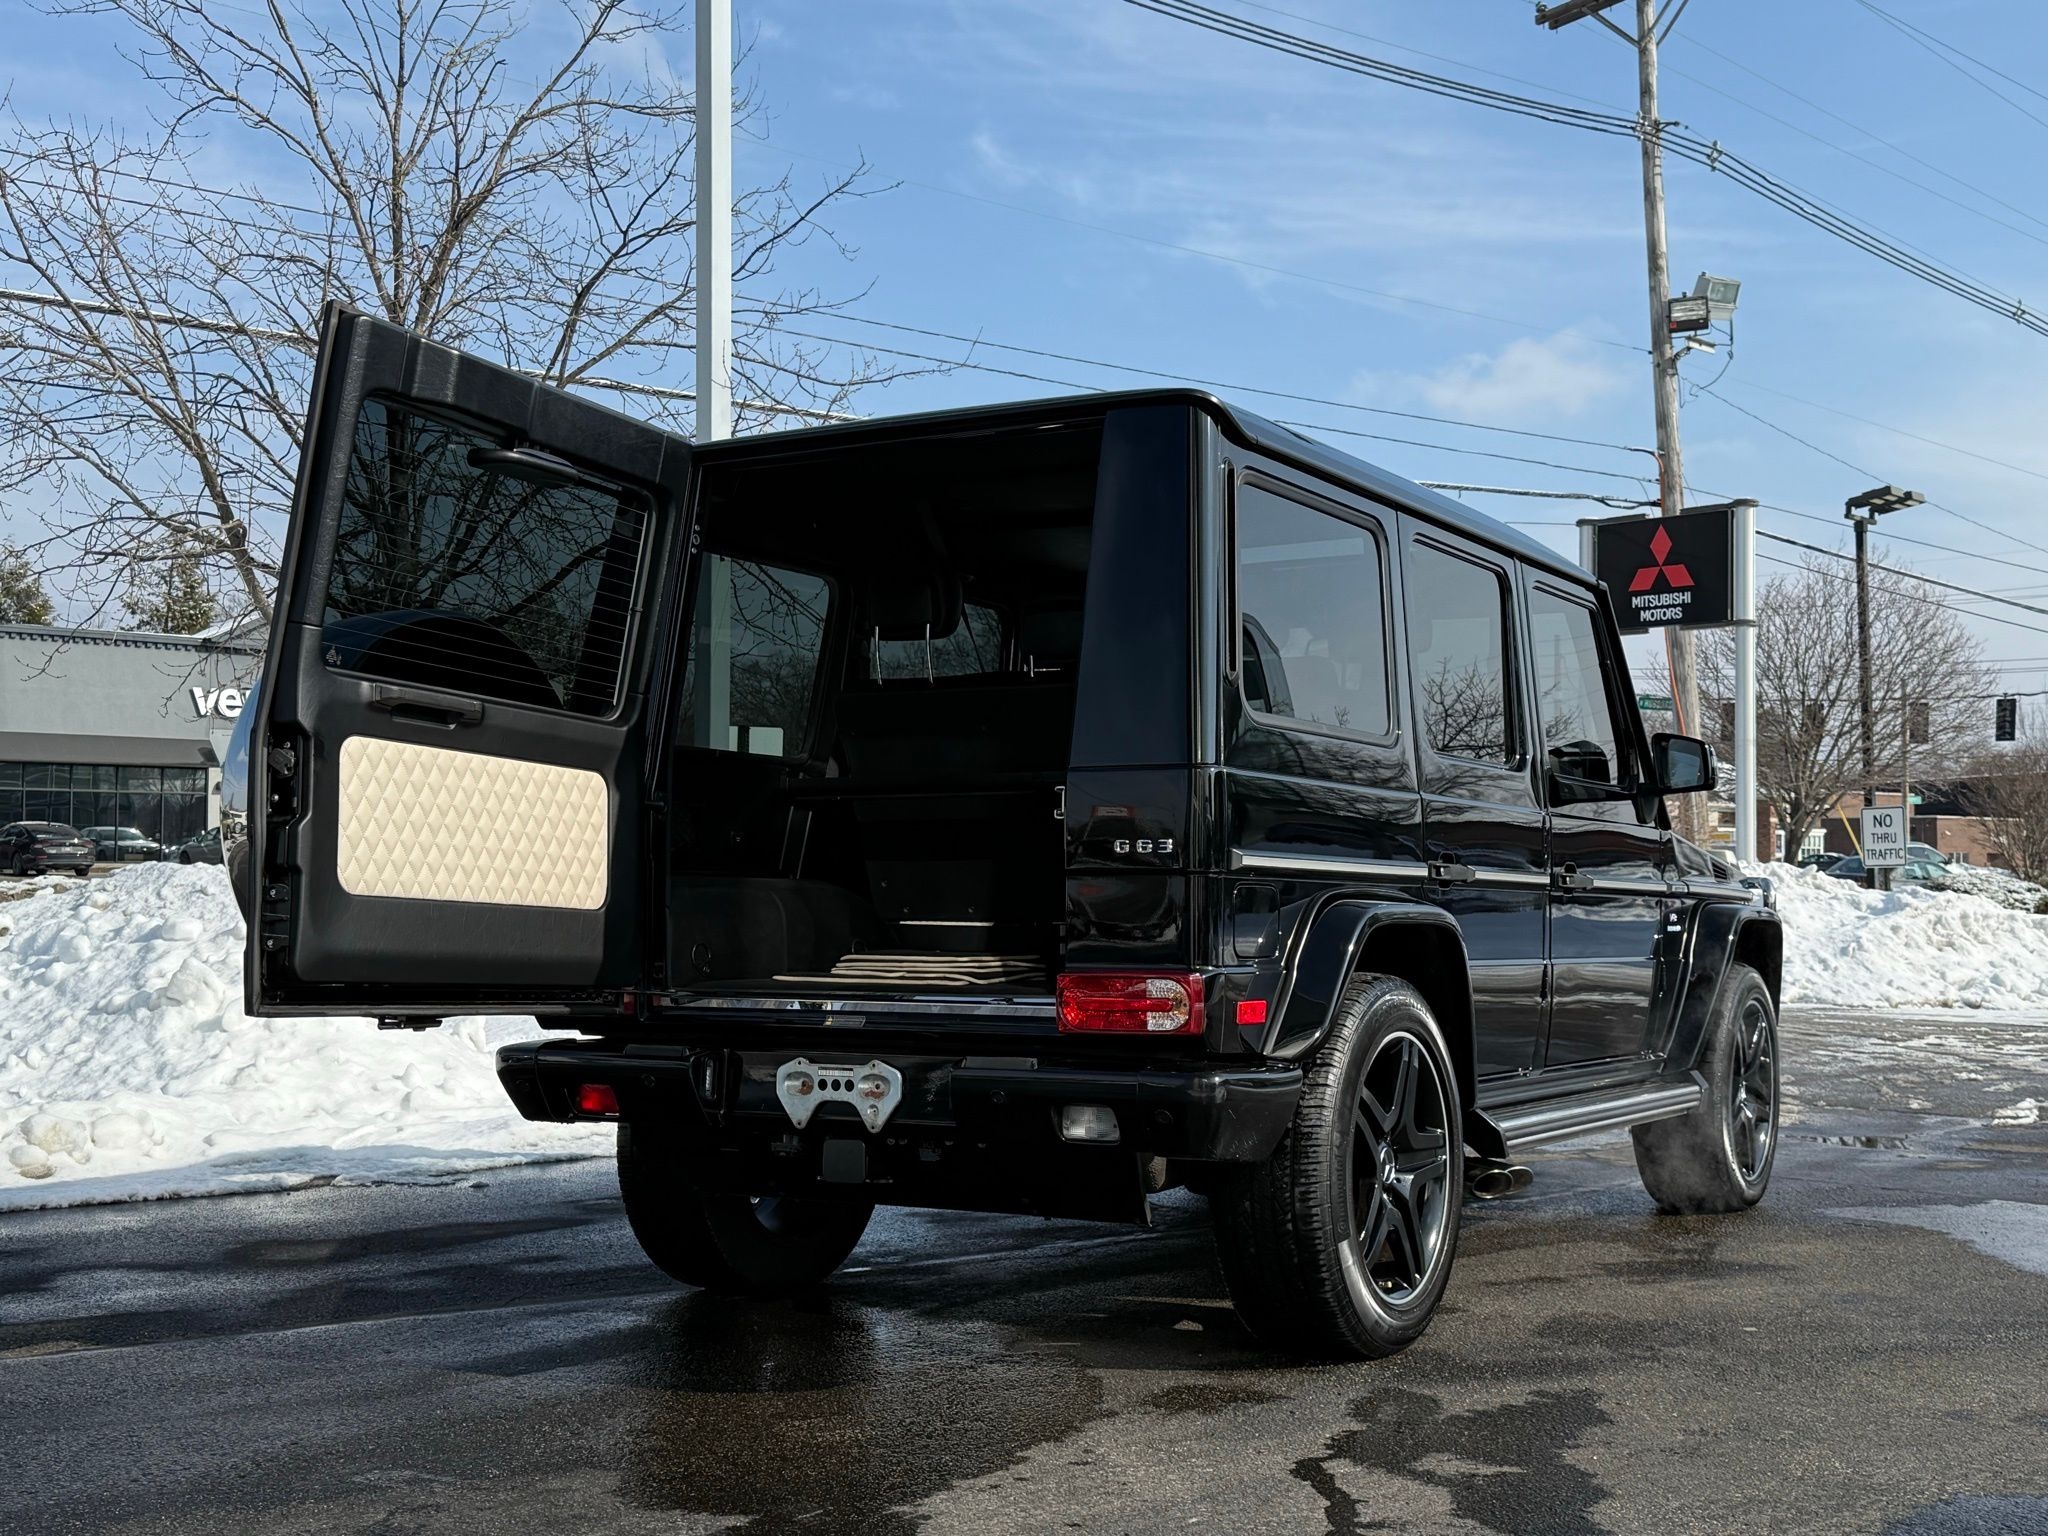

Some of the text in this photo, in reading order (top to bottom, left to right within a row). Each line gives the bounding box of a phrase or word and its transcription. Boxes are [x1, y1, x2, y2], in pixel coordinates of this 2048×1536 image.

[1632, 591, 1691, 608] MITSUBISHI
[1640, 607, 1683, 622] MOTORS
[190, 686, 252, 718] ve
[1873, 814, 1893, 828] NO
[1871, 832, 1897, 844] THRU
[1866, 847, 1904, 861] TRAFFIC
